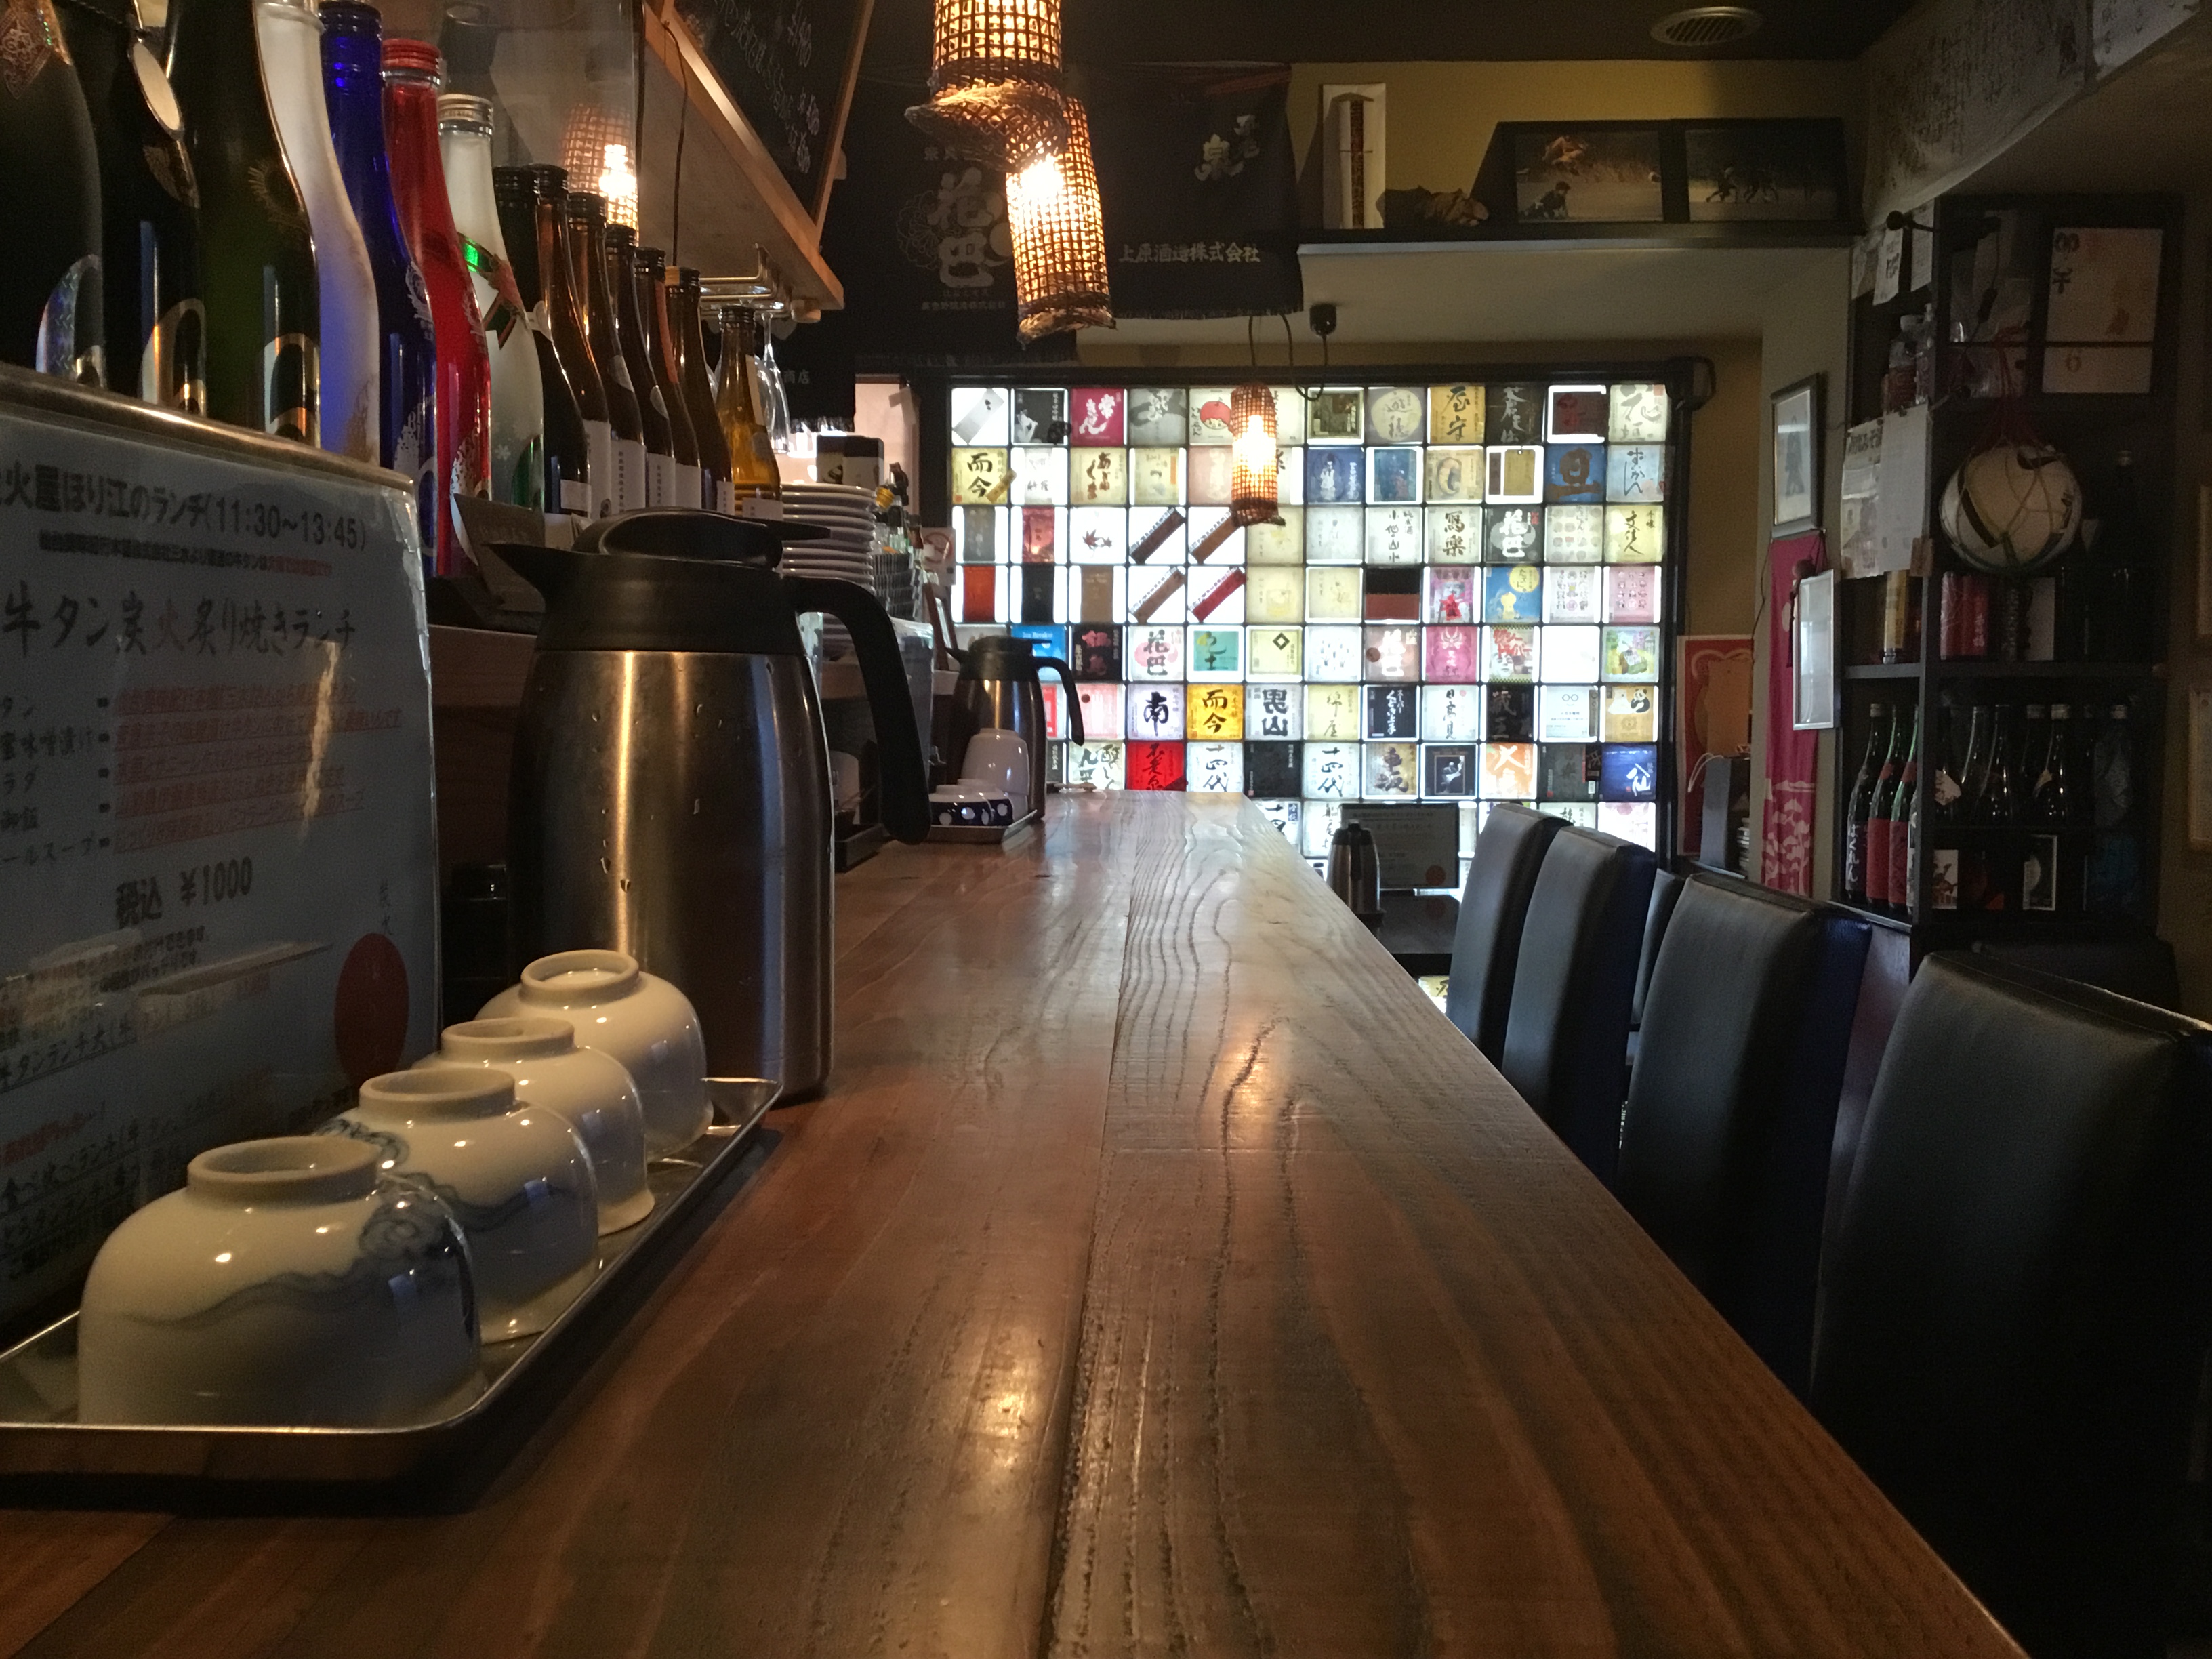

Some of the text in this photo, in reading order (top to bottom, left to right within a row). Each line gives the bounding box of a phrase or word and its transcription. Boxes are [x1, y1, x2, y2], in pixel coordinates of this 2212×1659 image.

[1118, 241, 1261, 263] 上原酒造株式会社
[967, 452, 992, 497] 而今
[1499, 509, 1528, 558] 花巴
[1144, 629, 1169, 676] 花巴
[1144, 691, 1169, 736] 南
[1201, 689, 1228, 733] 而今
[1443, 689, 1457, 739] 日高見
[1203, 745, 1229, 792] 十四代
[1317, 747, 1344, 797] 十四代
[1626, 763, 1652, 797] 八仙
[180, 855, 253, 908] ¥1000
